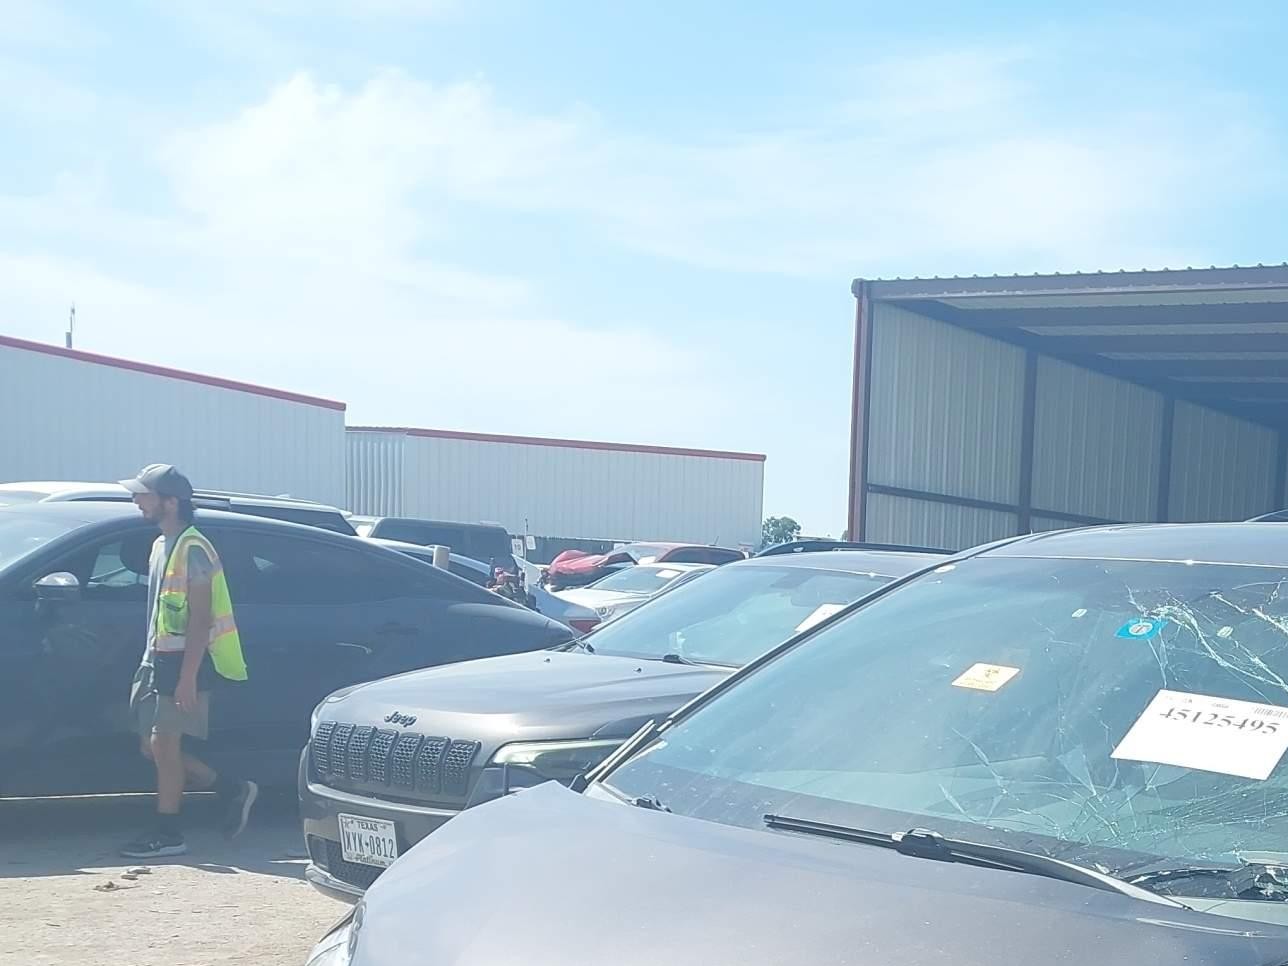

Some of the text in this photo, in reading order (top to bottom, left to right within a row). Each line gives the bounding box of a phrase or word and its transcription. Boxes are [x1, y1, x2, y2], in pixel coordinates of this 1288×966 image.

[383, 711, 418, 728] Jeep
[1159, 707, 1281, 735] 45125495
[356, 820, 379, 832] TEXAS
